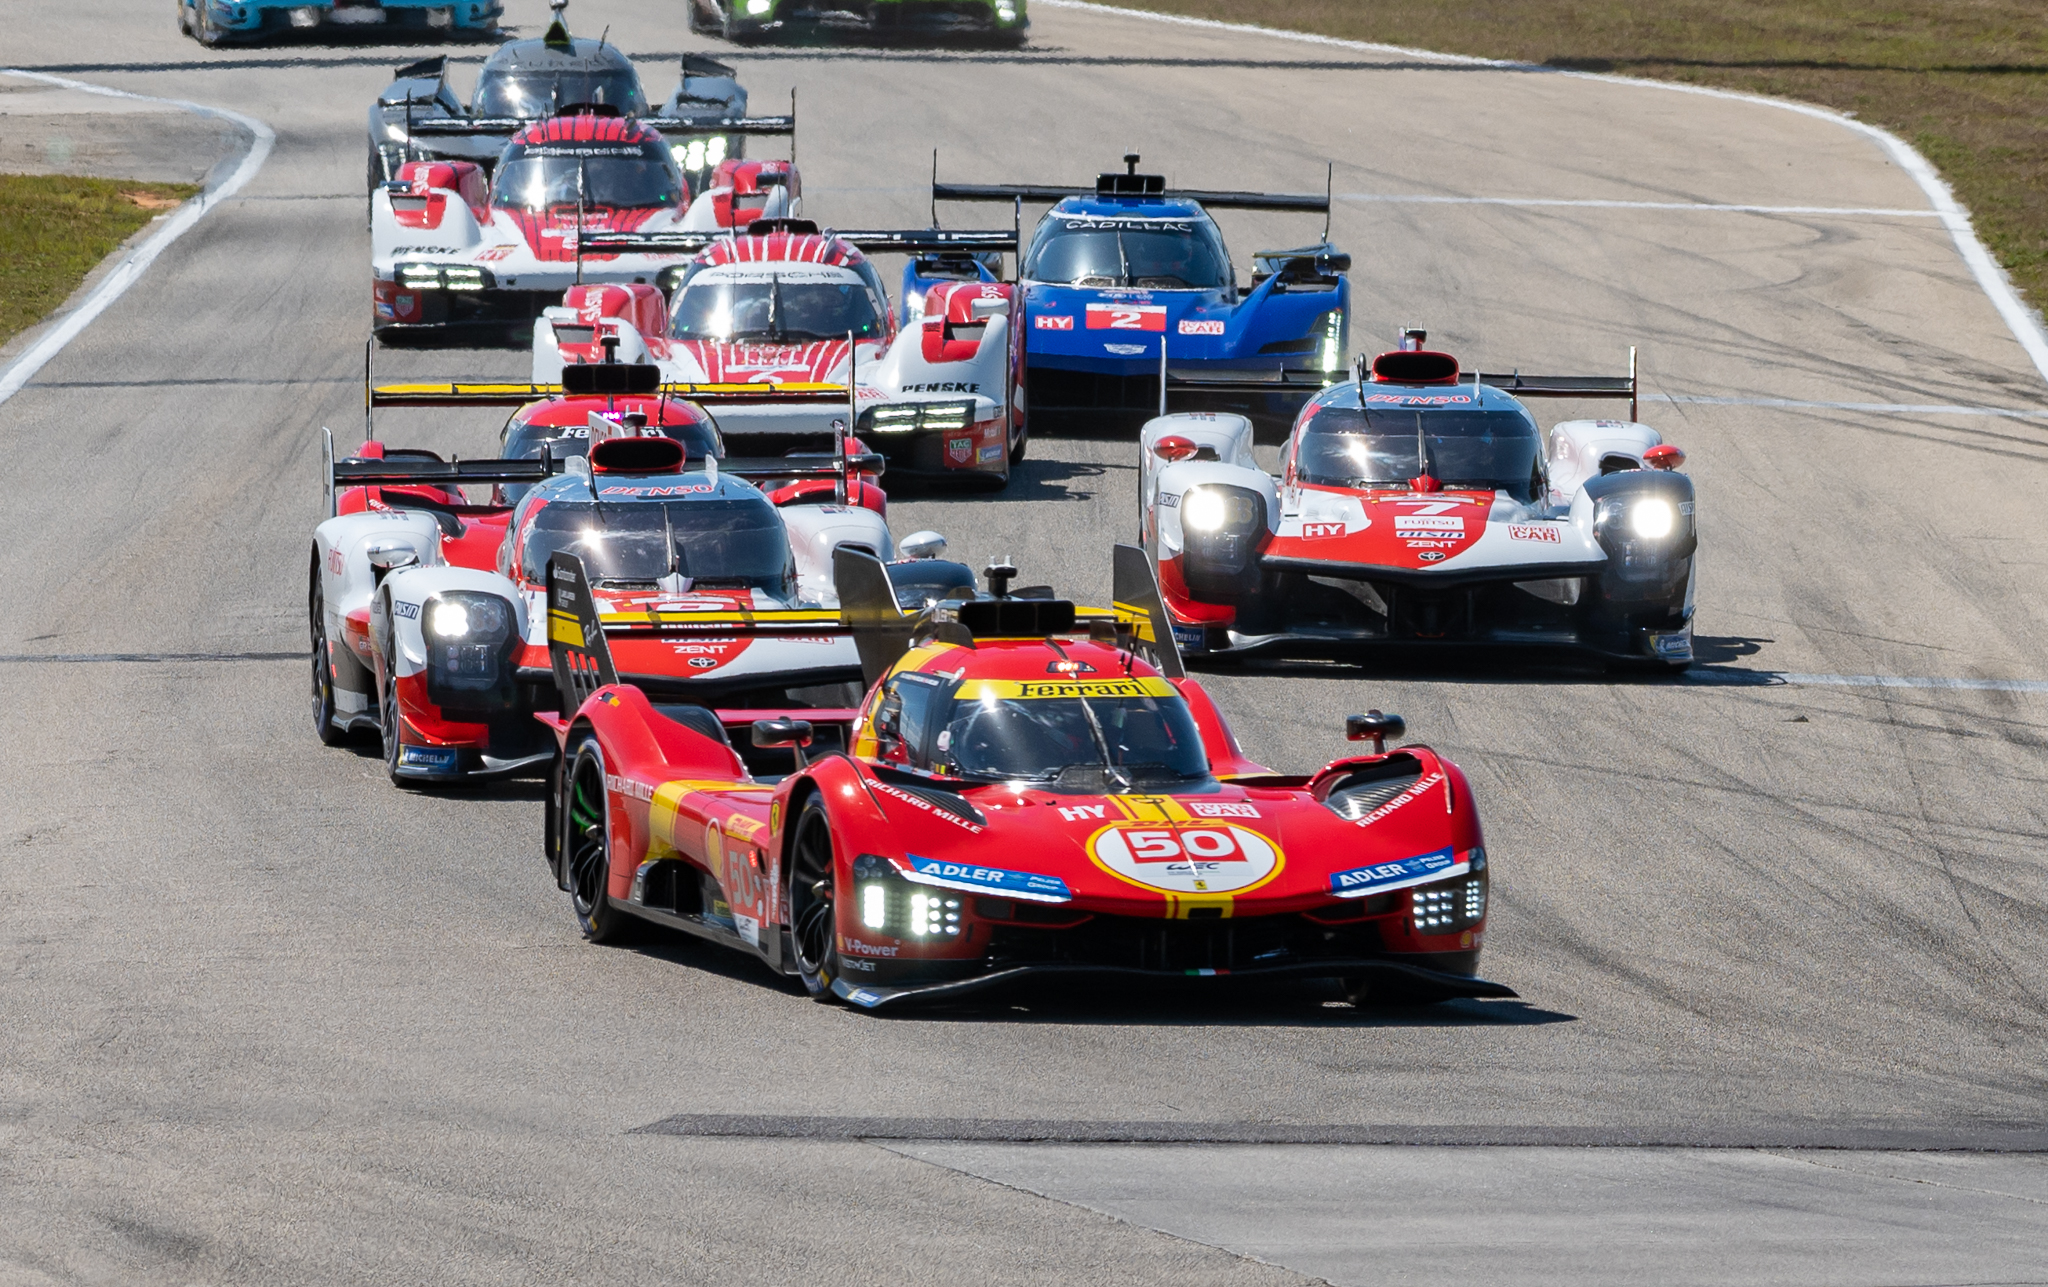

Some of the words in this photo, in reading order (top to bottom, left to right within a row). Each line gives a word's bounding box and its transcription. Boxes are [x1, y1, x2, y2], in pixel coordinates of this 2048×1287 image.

[1066, 220, 1192, 232] CADILLAC
[1037, 316, 1071, 328] HY
[1110, 312, 1142, 328] 2
[1180, 325, 1221, 333] CAR
[902, 382, 981, 394] PENSKE
[1365, 394, 1471, 405] DENSO
[557, 426, 668, 438] Feri
[951, 439, 971, 448] TAG
[599, 484, 715, 496] DENSO
[1396, 502, 1460, 515] 7
[1404, 518, 1455, 527] FUJITSU
[1304, 524, 1342, 537] HY
[1398, 531, 1464, 539] AISIN
[1512, 526, 1556, 534] HYPER
[1513, 531, 1556, 542] CAR
[1406, 540, 1457, 548] ZENT
[395, 602, 419, 619] AISIN
[673, 645, 727, 654] ZENT
[1017, 680, 1146, 698] Ferrari
[1356, 793, 1414, 828] RICHARD
[1409, 772, 1444, 797] MILLE
[865, 778, 932, 811] RICHARD
[932, 808, 983, 835] MILLE
[1058, 804, 1106, 822] HY
[1127, 830, 1236, 858] 50
[1425, 859, 1451, 870] GROUP
[728, 850, 755, 908] 50
[919, 863, 1005, 883] ADLER
[1338, 863, 1409, 887] ADLER
[1027, 881, 1060, 891] GROUP
[844, 937, 899, 957] V-Power
